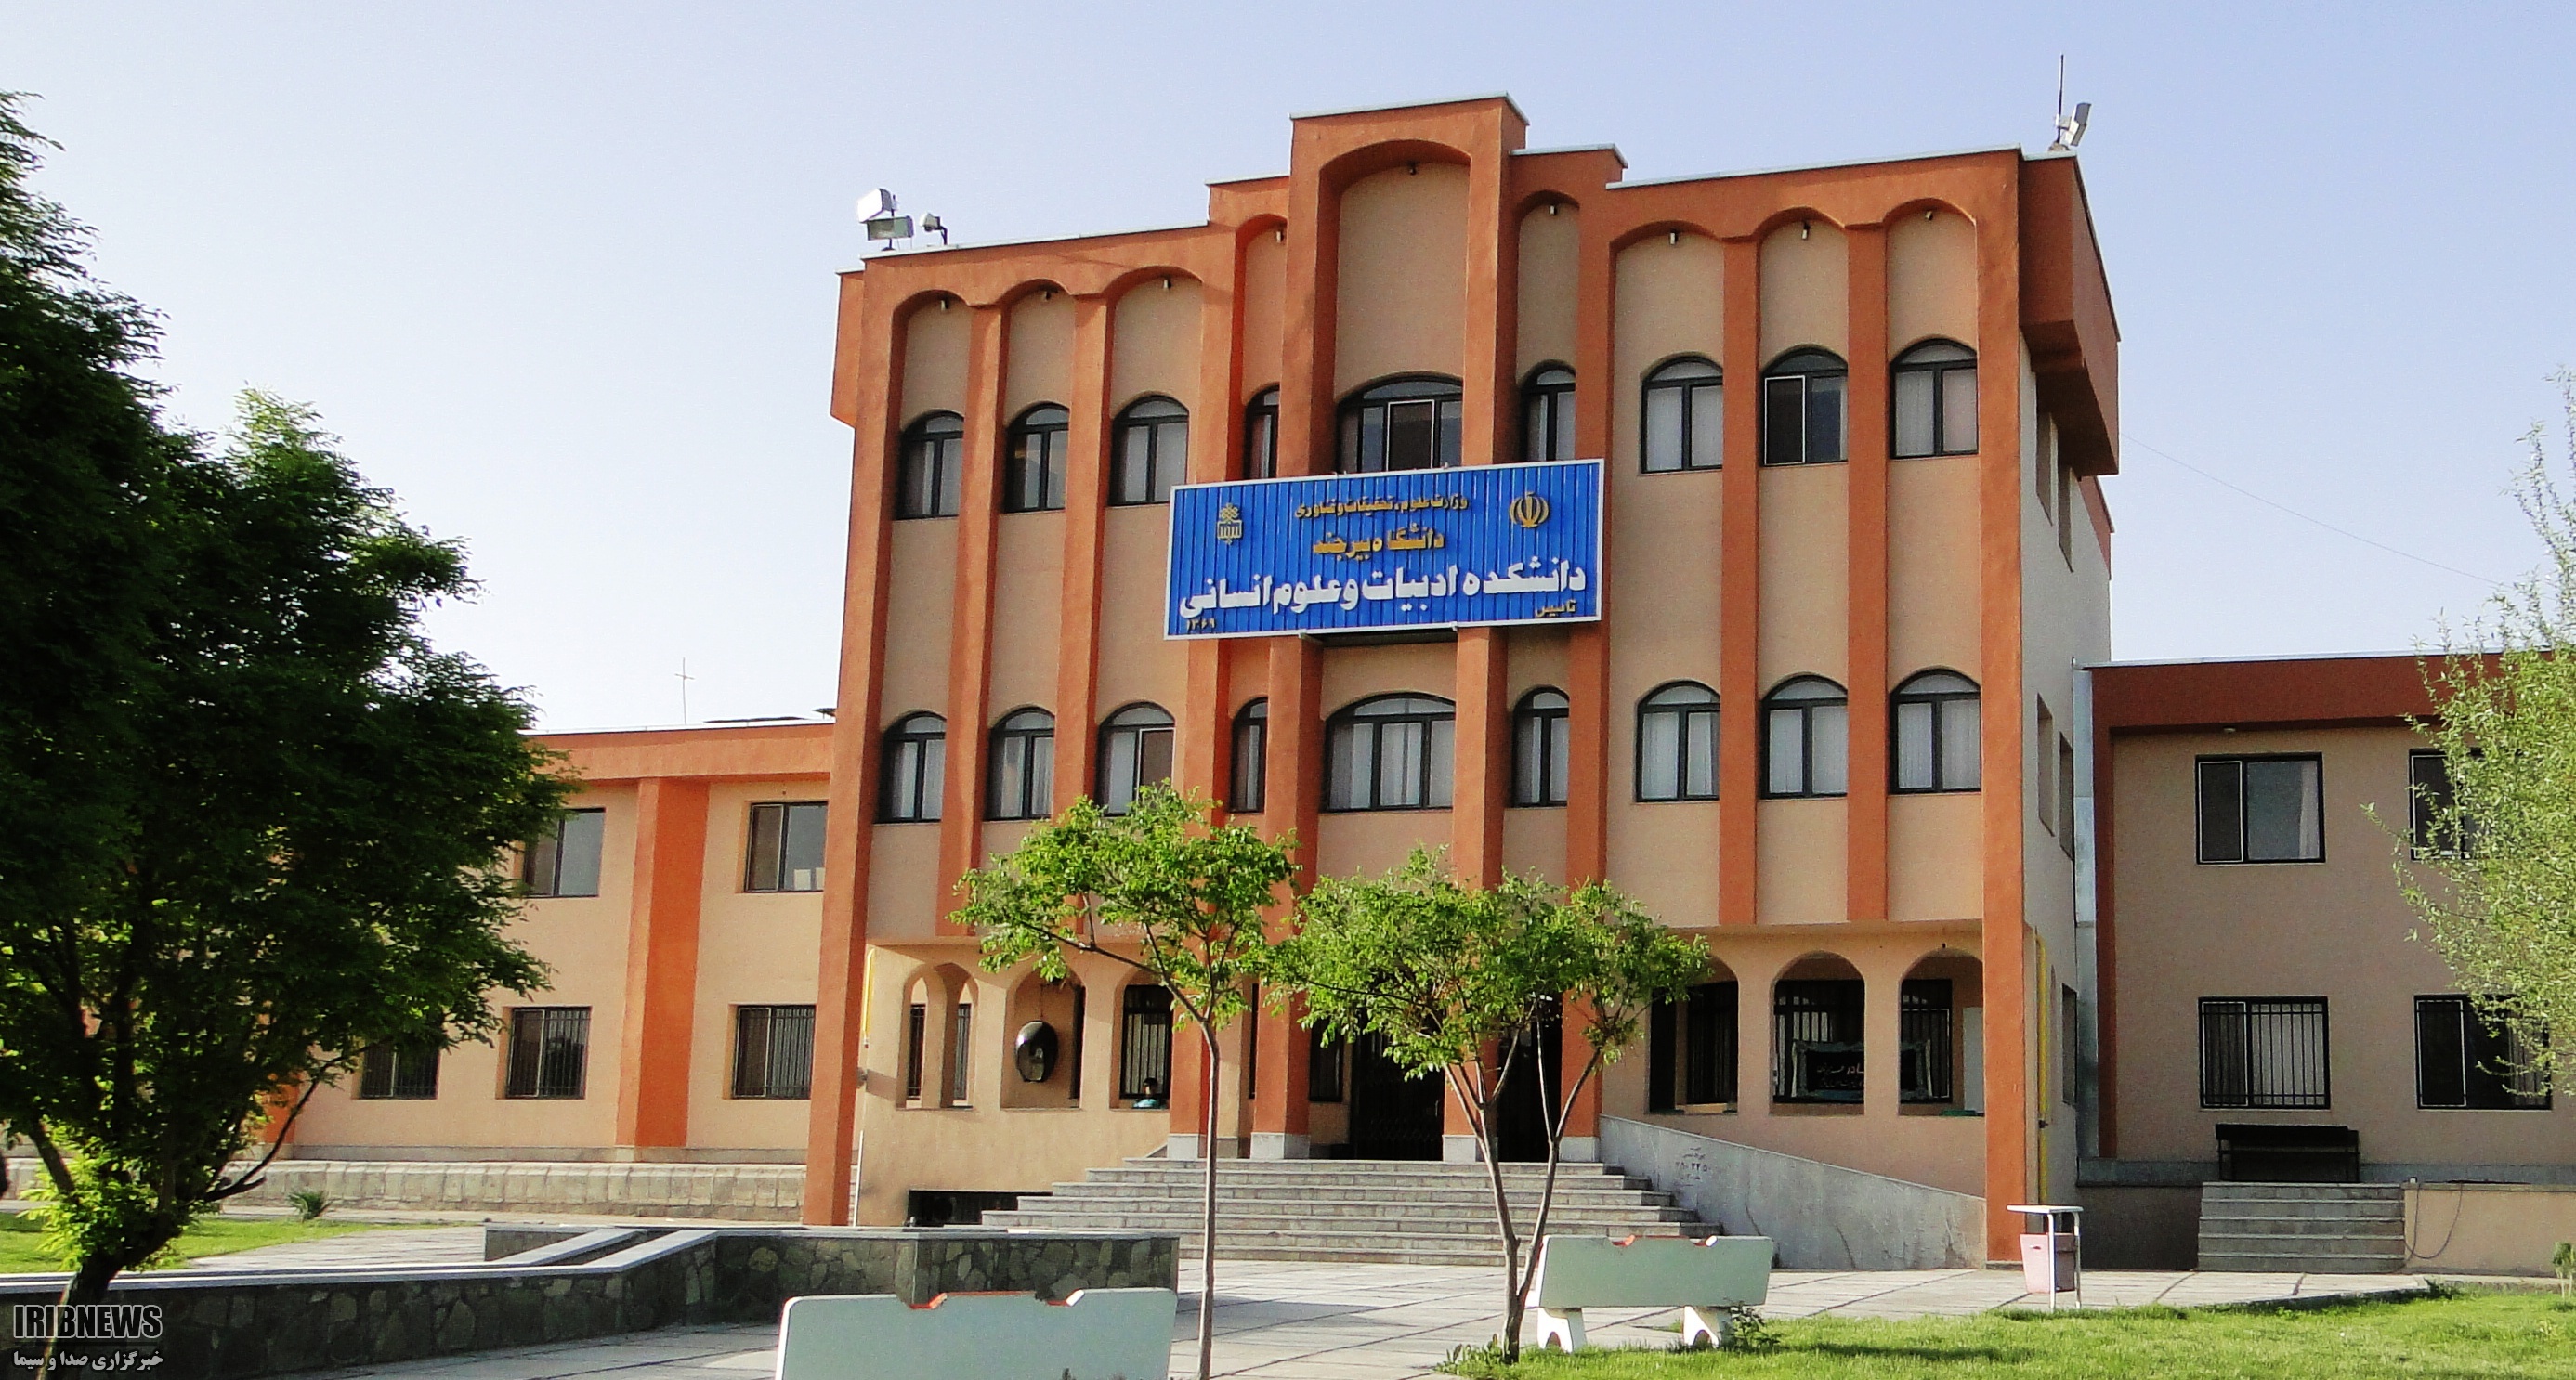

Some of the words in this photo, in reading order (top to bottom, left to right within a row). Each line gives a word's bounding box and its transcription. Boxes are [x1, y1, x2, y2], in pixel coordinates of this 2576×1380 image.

[1313, 531, 1371, 562] بیرجند
[1179, 573, 1273, 618] انسانی
[1361, 564, 1458, 612] ادبیات
[1462, 555, 1586, 596] دانشکده
